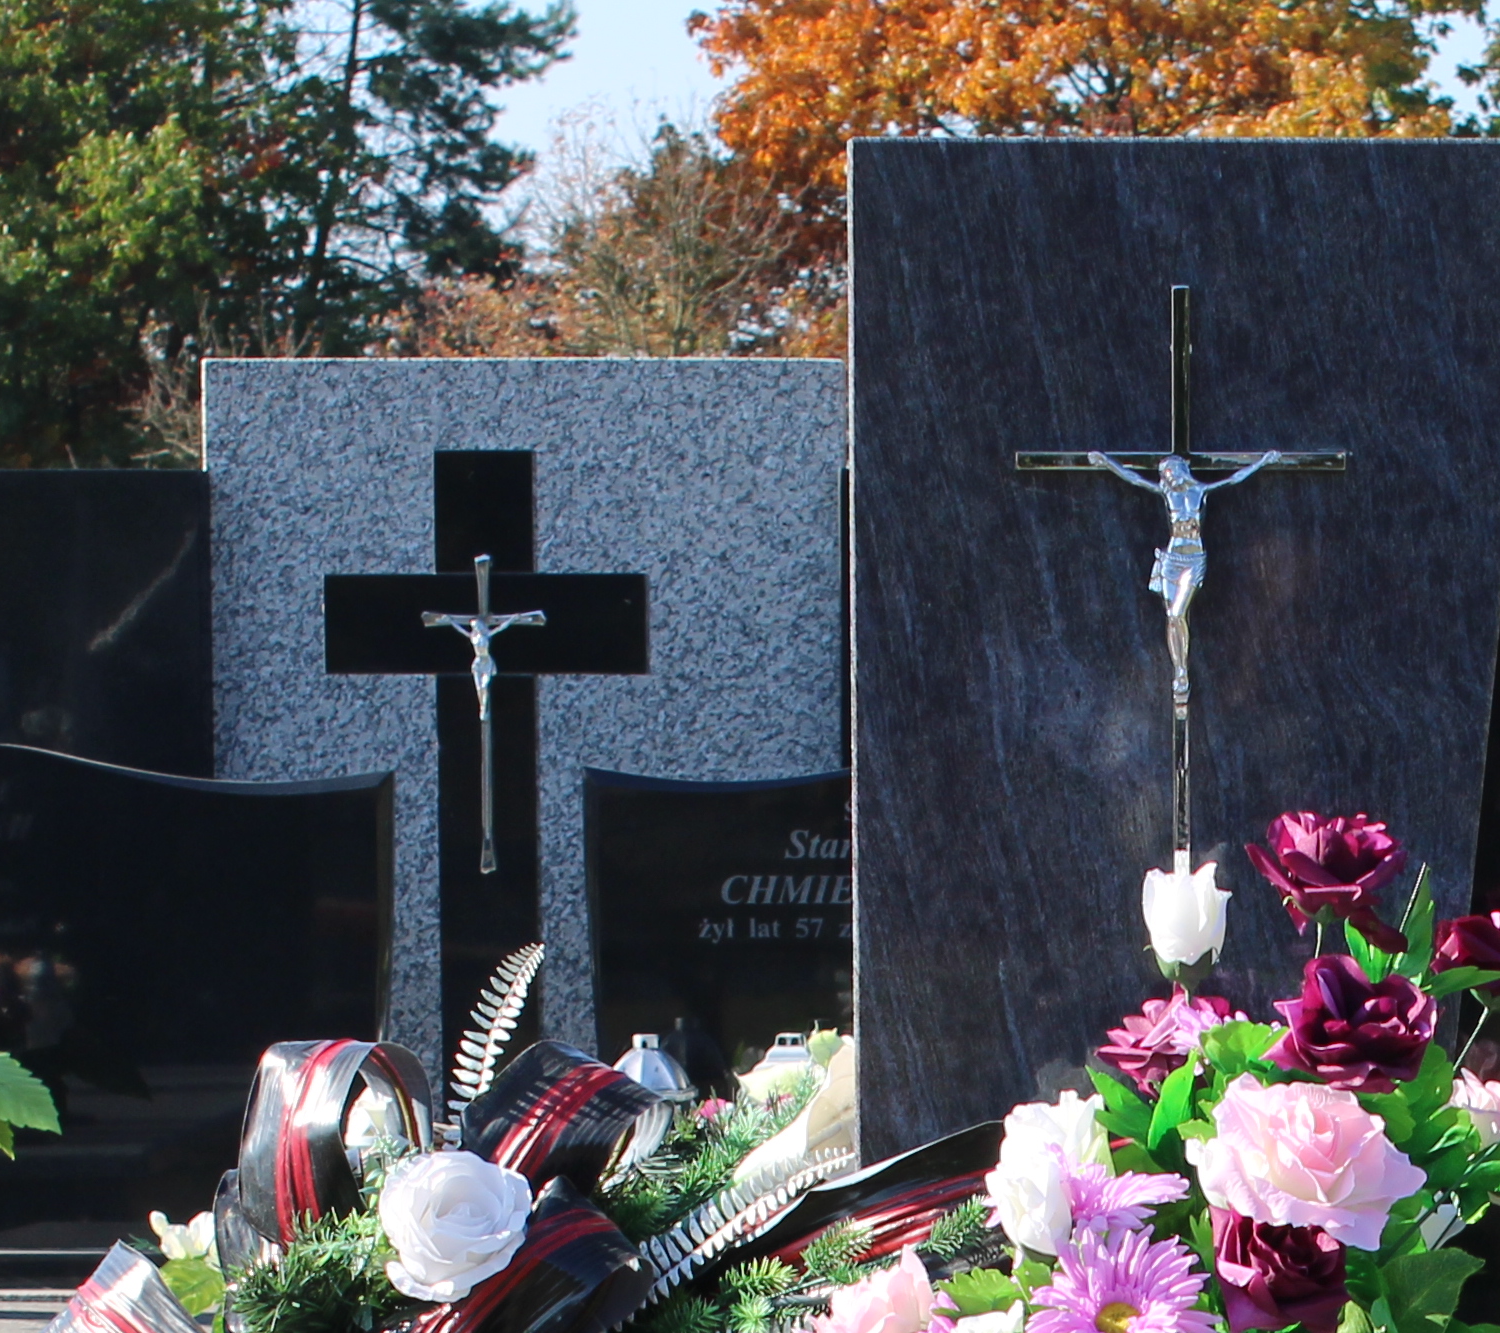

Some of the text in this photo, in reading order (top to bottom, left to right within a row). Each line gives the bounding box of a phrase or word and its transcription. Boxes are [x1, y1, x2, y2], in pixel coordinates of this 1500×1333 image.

[699, 917, 735, 944] żył
[749, 917, 781, 939] lat
[795, 917, 825, 939] 57
